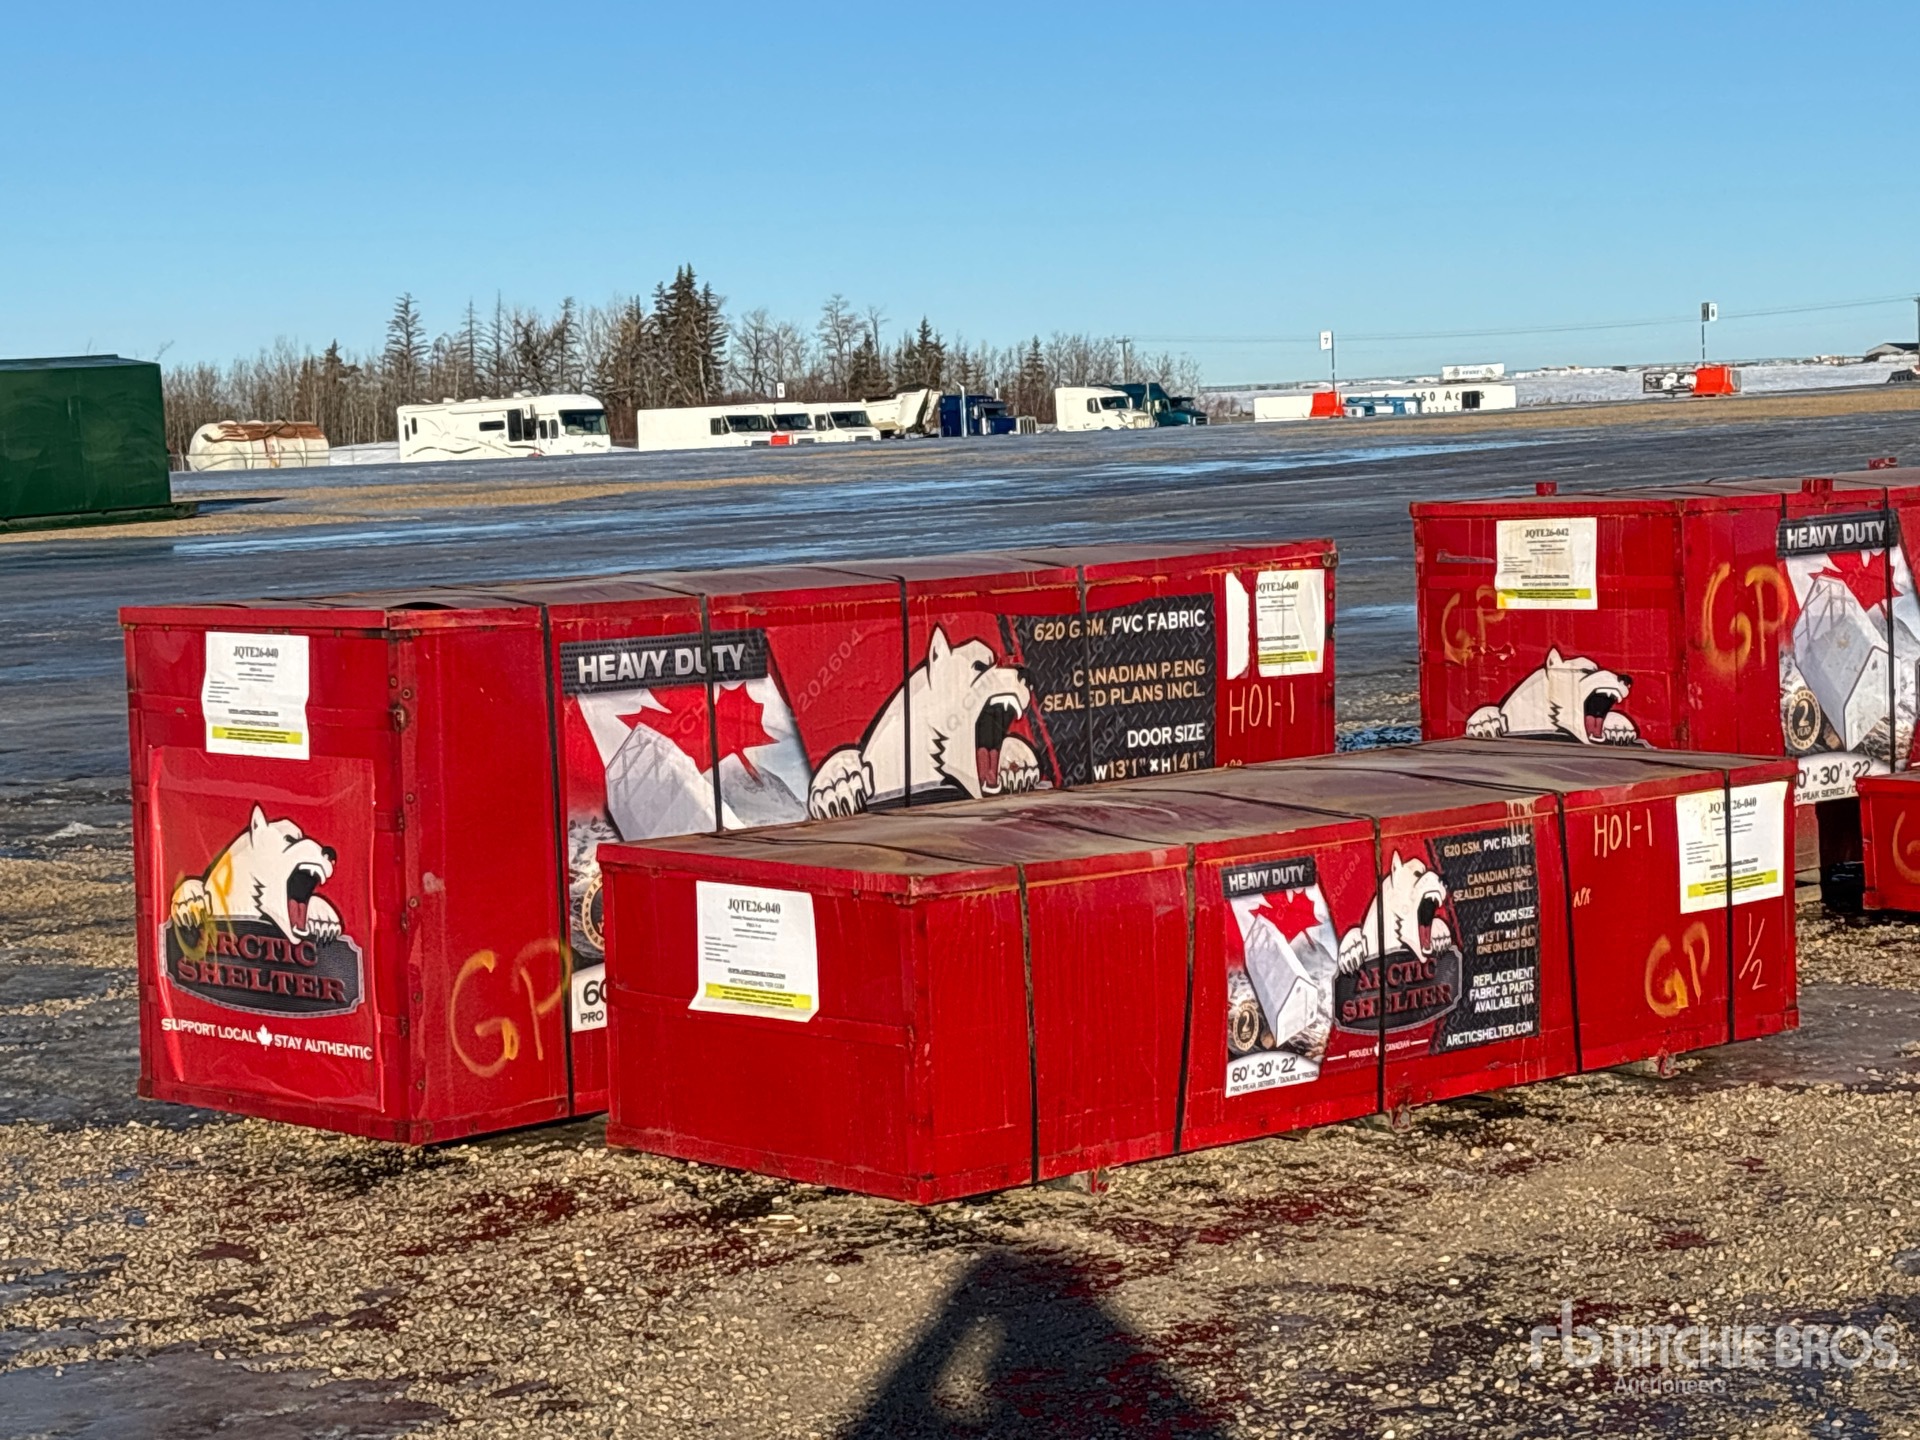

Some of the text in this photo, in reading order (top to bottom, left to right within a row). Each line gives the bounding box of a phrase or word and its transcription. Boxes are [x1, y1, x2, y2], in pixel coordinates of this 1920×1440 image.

[1444, 390, 1485, 402] Acs
[1786, 520, 1885, 549] HEAVY DUTY
[1034, 622, 1065, 641] 620
[1111, 614, 1144, 635] PVC
[1147, 609, 1206, 631] FABRIC
[578, 650, 667, 684] HEAVY
[1110, 684, 1164, 706] PLANS
[1798, 700, 1810, 727] 2
[1127, 723, 1206, 749] DOOR SIZE
[1796, 767, 1810, 790] 0'
[1820, 763, 1843, 786] 30'
[1802, 790, 1820, 801] PEAK
[1821, 786, 1846, 799] SERIES
[1444, 843, 1460, 857] 620
[1483, 837, 1500, 851] PVC
[1501, 833, 1531, 849] FABRIC
[1228, 864, 1305, 892] HEAVY DUTY
[1467, 869, 1509, 885] CANADIAN
[1453, 886, 1485, 902] SEALED
[1486, 882, 1512, 897] PLANS
[728, 898, 781, 914] JQTE26-040
[1494, 906, 1535, 924] DOOR SIZE
[200, 929, 318, 967] ARCTIC
[178, 958, 347, 1001] SHELTER
[1473, 967, 1535, 987] REPLACEMENT
[1469, 980, 1534, 1001] FABRIC & PARTS
[1474, 992, 1534, 1013] AVAILABLE VIA
[580, 1010, 604, 1025] PRO
[1241, 1010, 1250, 1033] 2
[161, 1018, 373, 1060] SUPPORT LOCAL STAY AUTHENTIC
[1446, 1021, 1534, 1047] ARCTICSHELTER.COM
[1232, 1064, 1249, 1083] 60'
[1256, 1059, 1275, 1078] 30'
[1281, 1055, 1299, 1074] 22'
